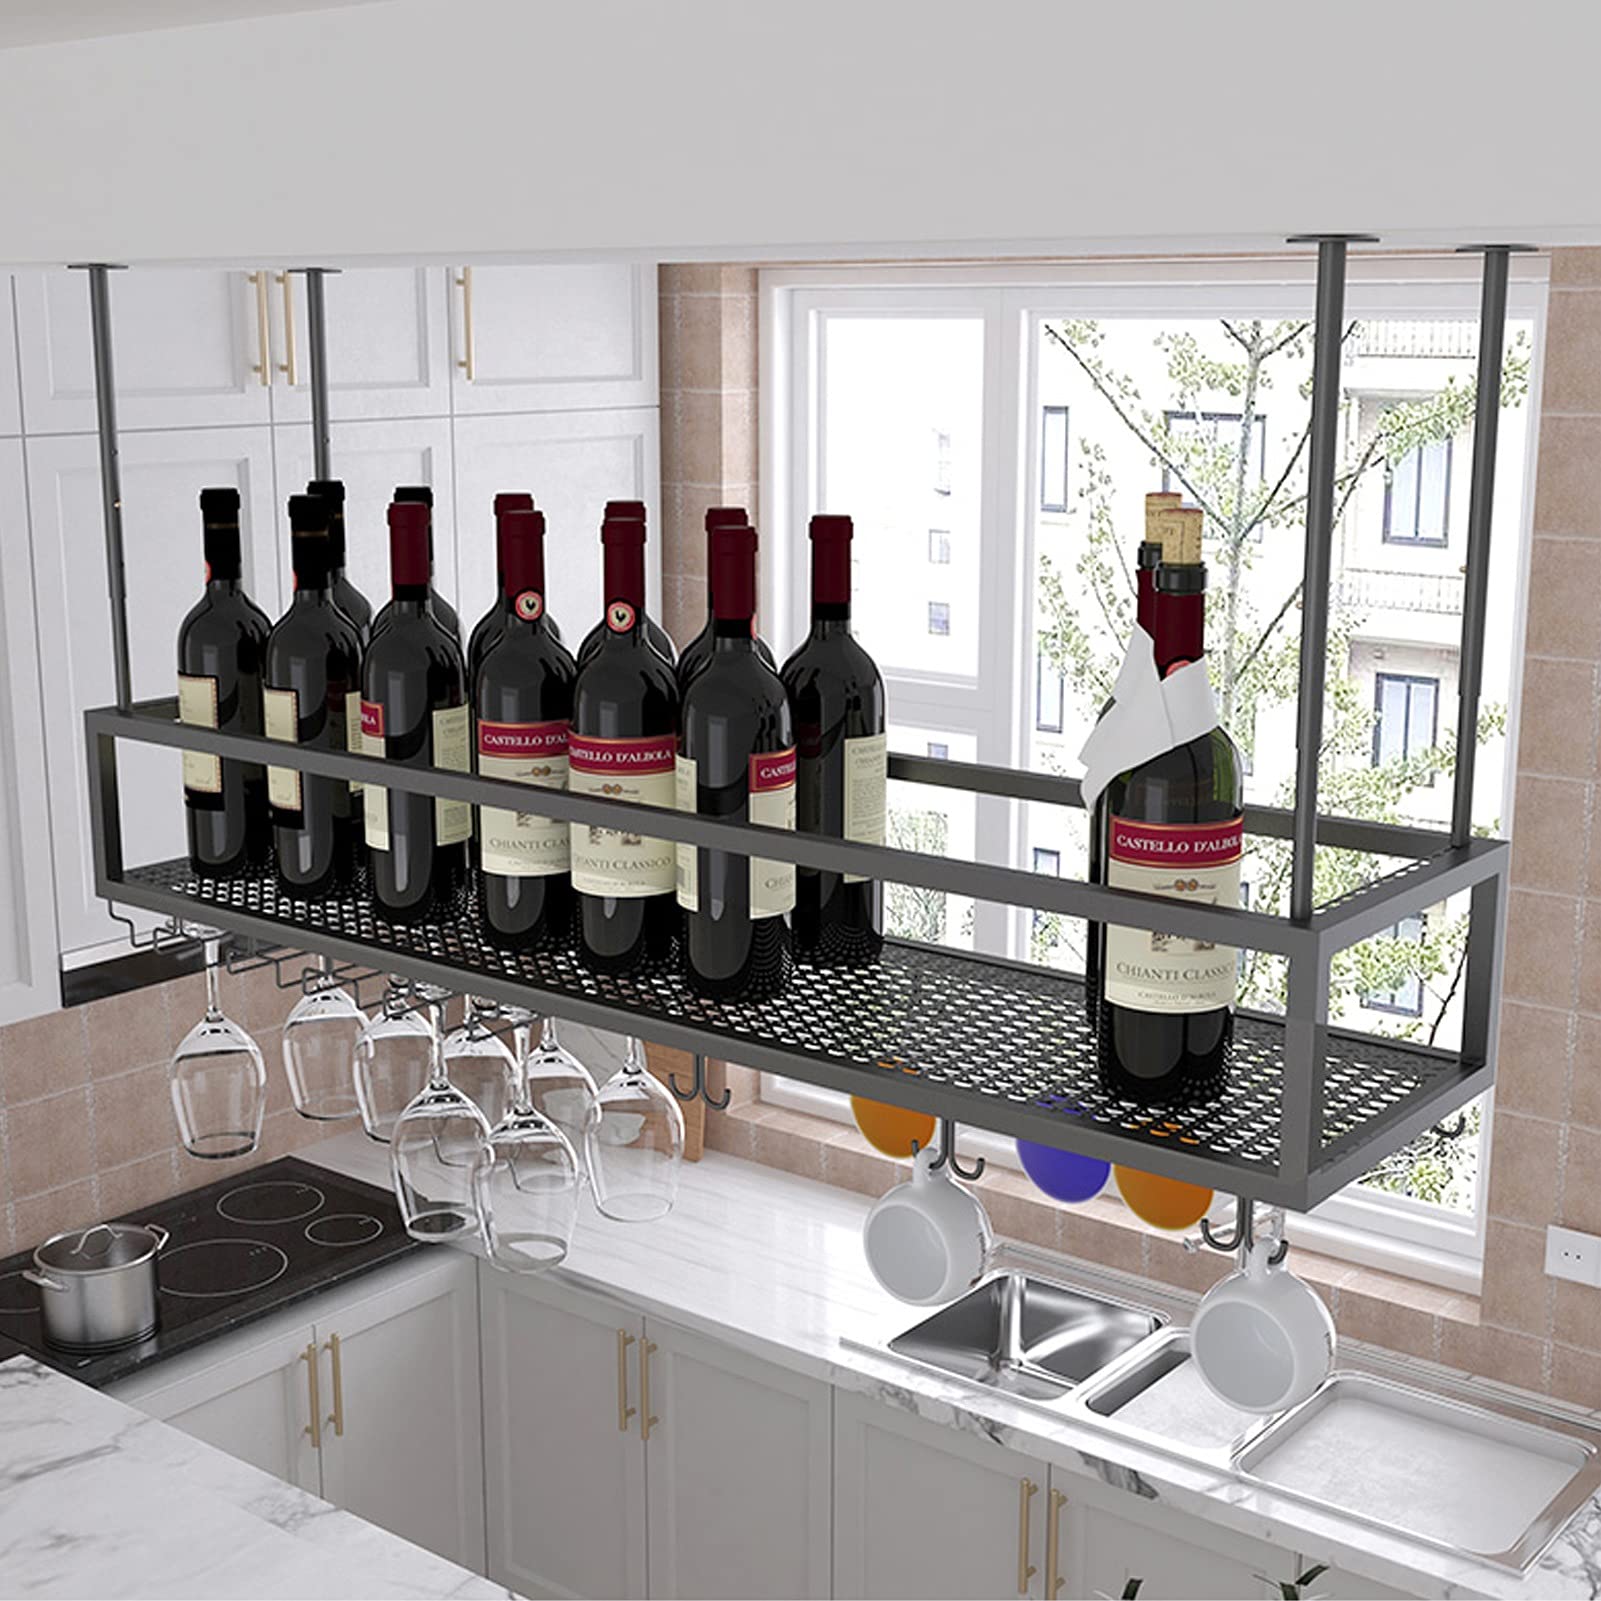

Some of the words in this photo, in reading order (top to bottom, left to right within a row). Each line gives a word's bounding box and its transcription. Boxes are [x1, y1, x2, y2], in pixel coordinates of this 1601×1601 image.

[484, 733, 543, 747] CASTELLO
[615, 748, 673, 764] D'ALBOLA
[489, 837, 540, 849] CHIANTI
[1116, 834, 1189, 853] CASTELLO
[612, 856, 672, 870] CLASSICO
[1116, 961, 1180, 981] CHIANTI
